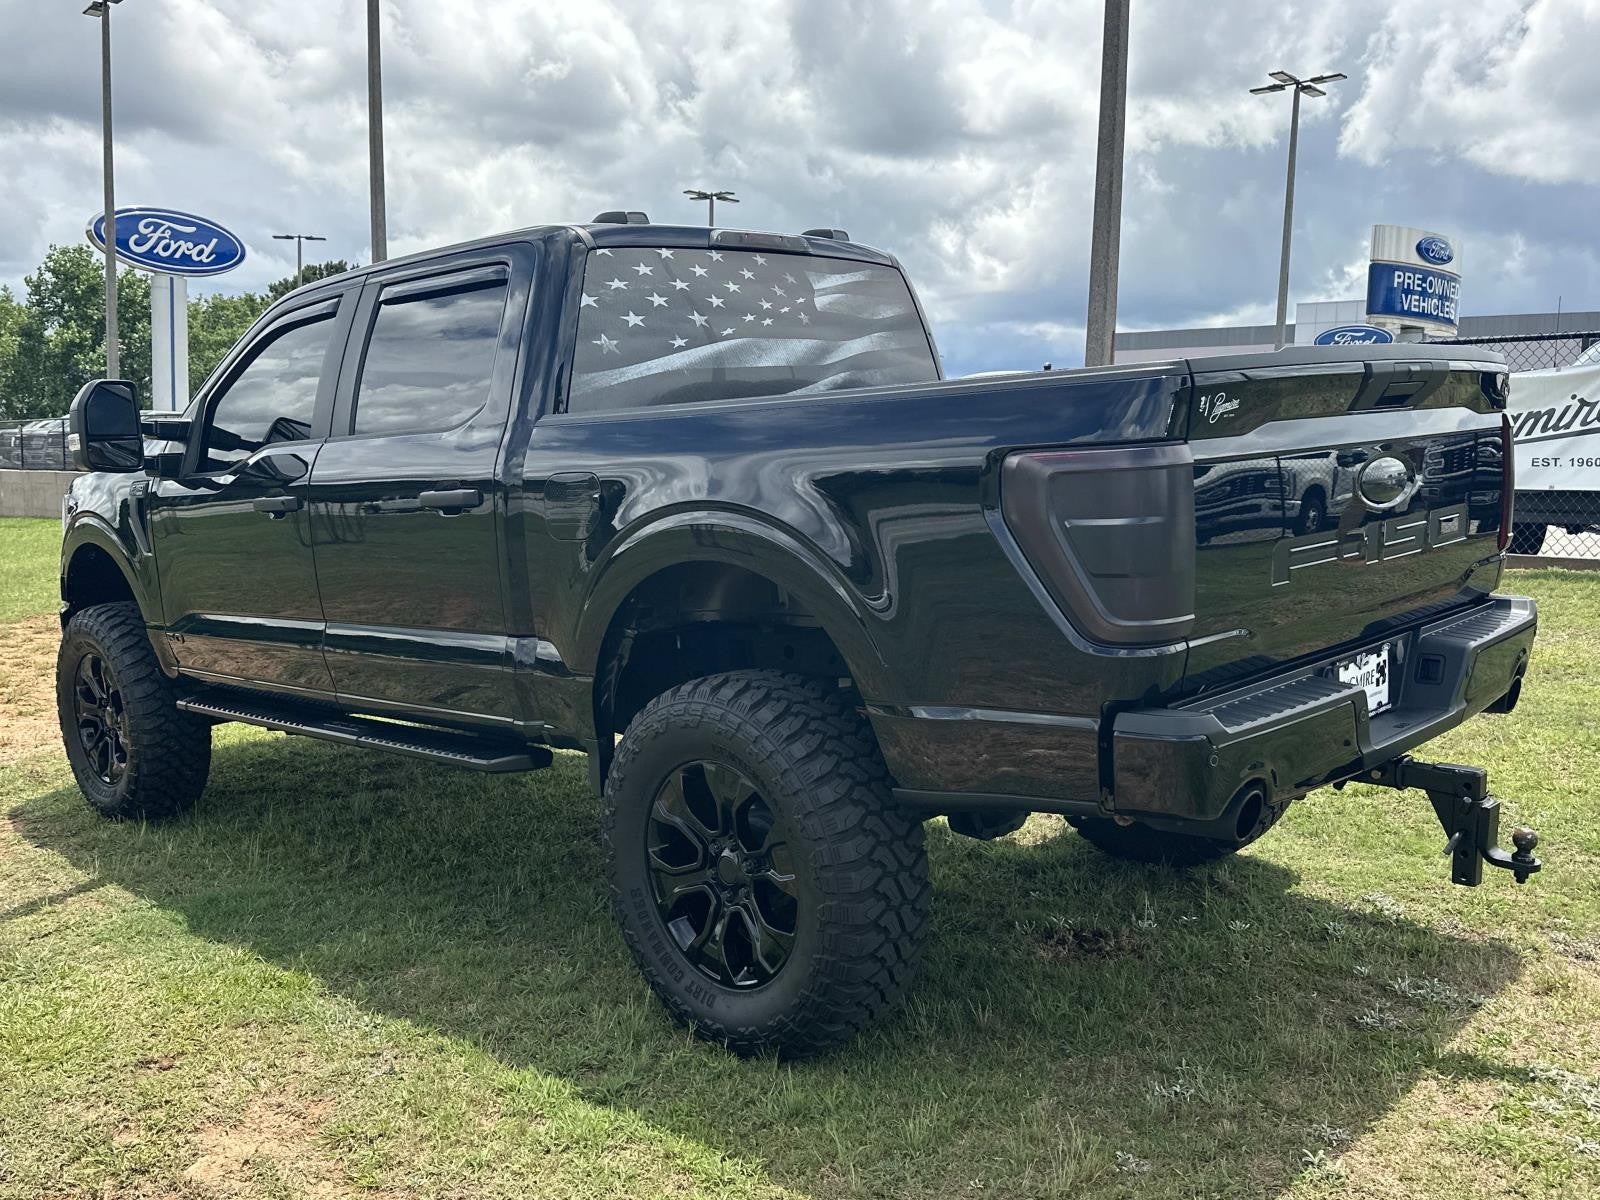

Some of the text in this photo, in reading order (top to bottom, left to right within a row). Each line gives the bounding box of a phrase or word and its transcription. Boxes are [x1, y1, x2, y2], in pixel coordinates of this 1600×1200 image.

[129, 217, 218, 263] Ford
[1429, 241, 1451, 260] Ford
[1393, 270, 1460, 299] PRE-OWNED
[1401, 294, 1456, 320] VEHICLES
[1531, 457, 1600, 467] EST. 1960
[684, 980, 716, 1008] DIRT
